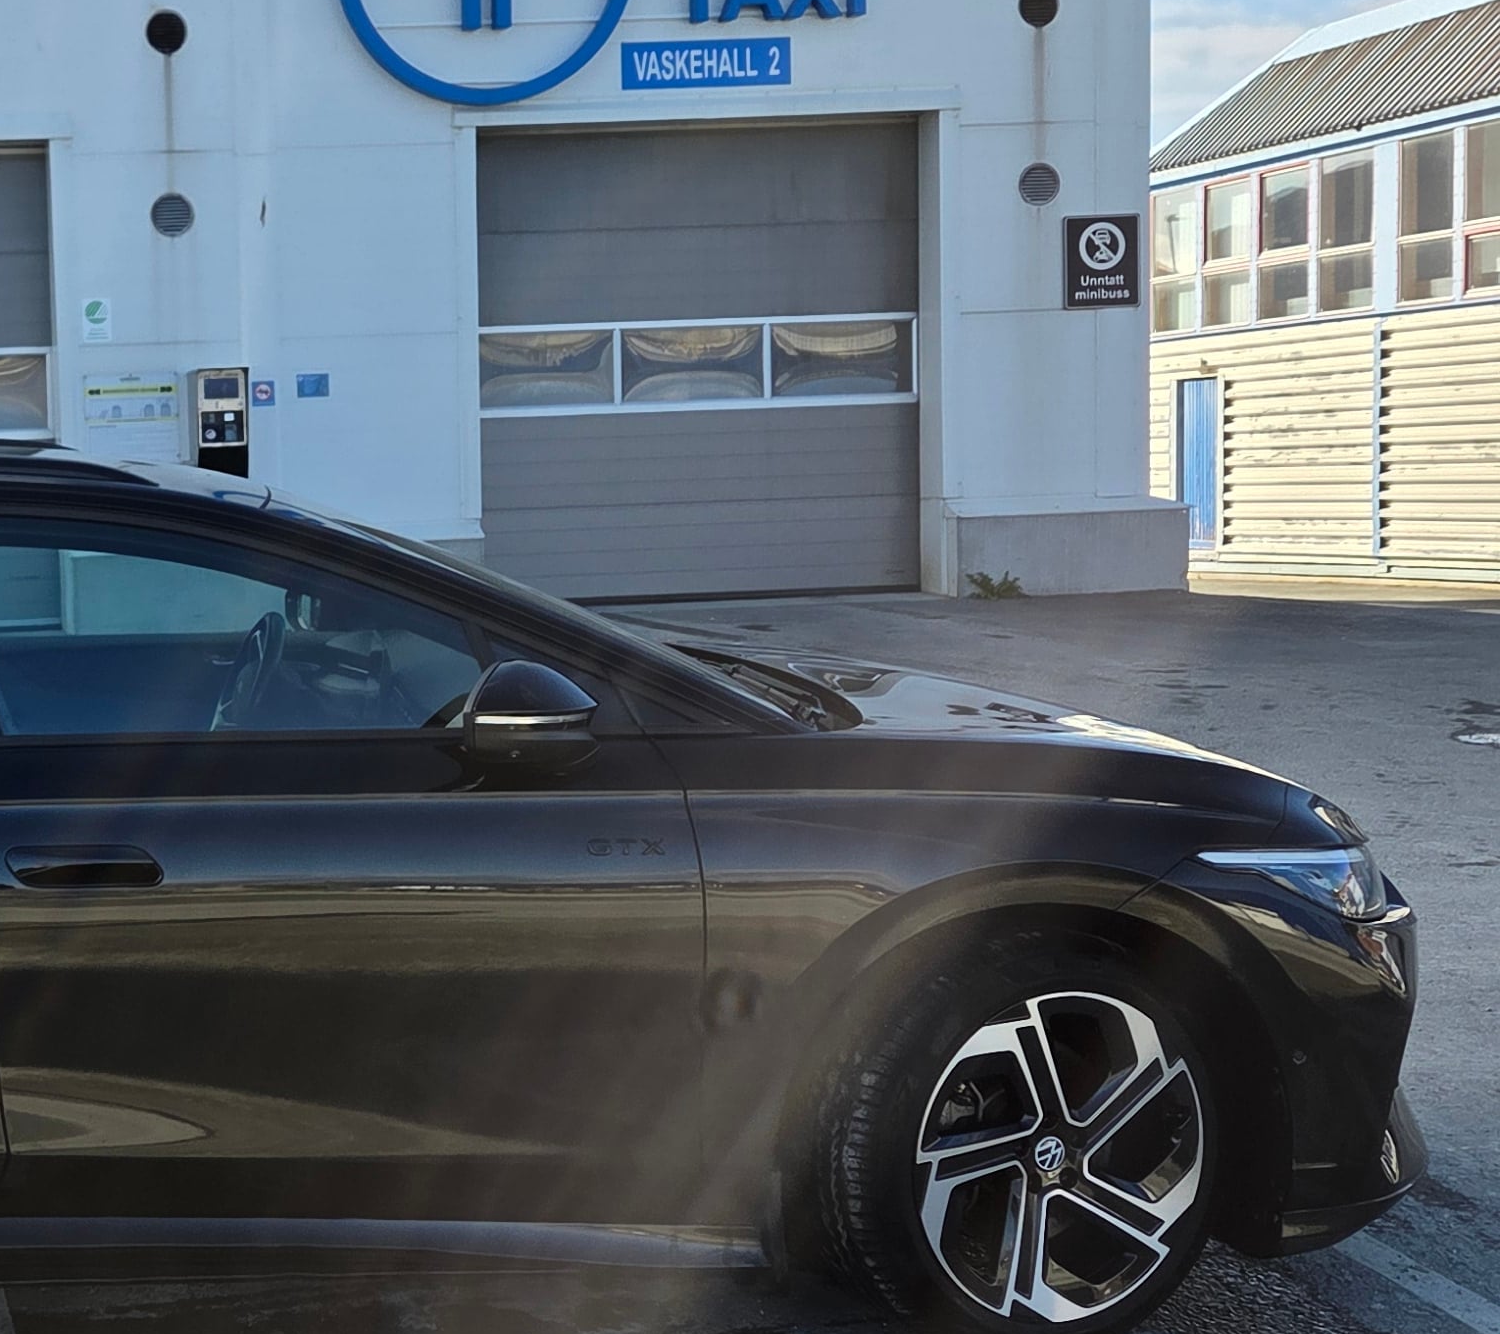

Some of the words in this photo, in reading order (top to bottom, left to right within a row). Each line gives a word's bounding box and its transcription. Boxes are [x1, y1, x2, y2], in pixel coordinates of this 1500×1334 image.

[633, 46, 759, 82] VASKEHALL
[768, 45, 781, 76] 2
[1080, 274, 1125, 286] Unntatt
[1074, 288, 1130, 300] minibuss
[586, 837, 666, 856] GTX
